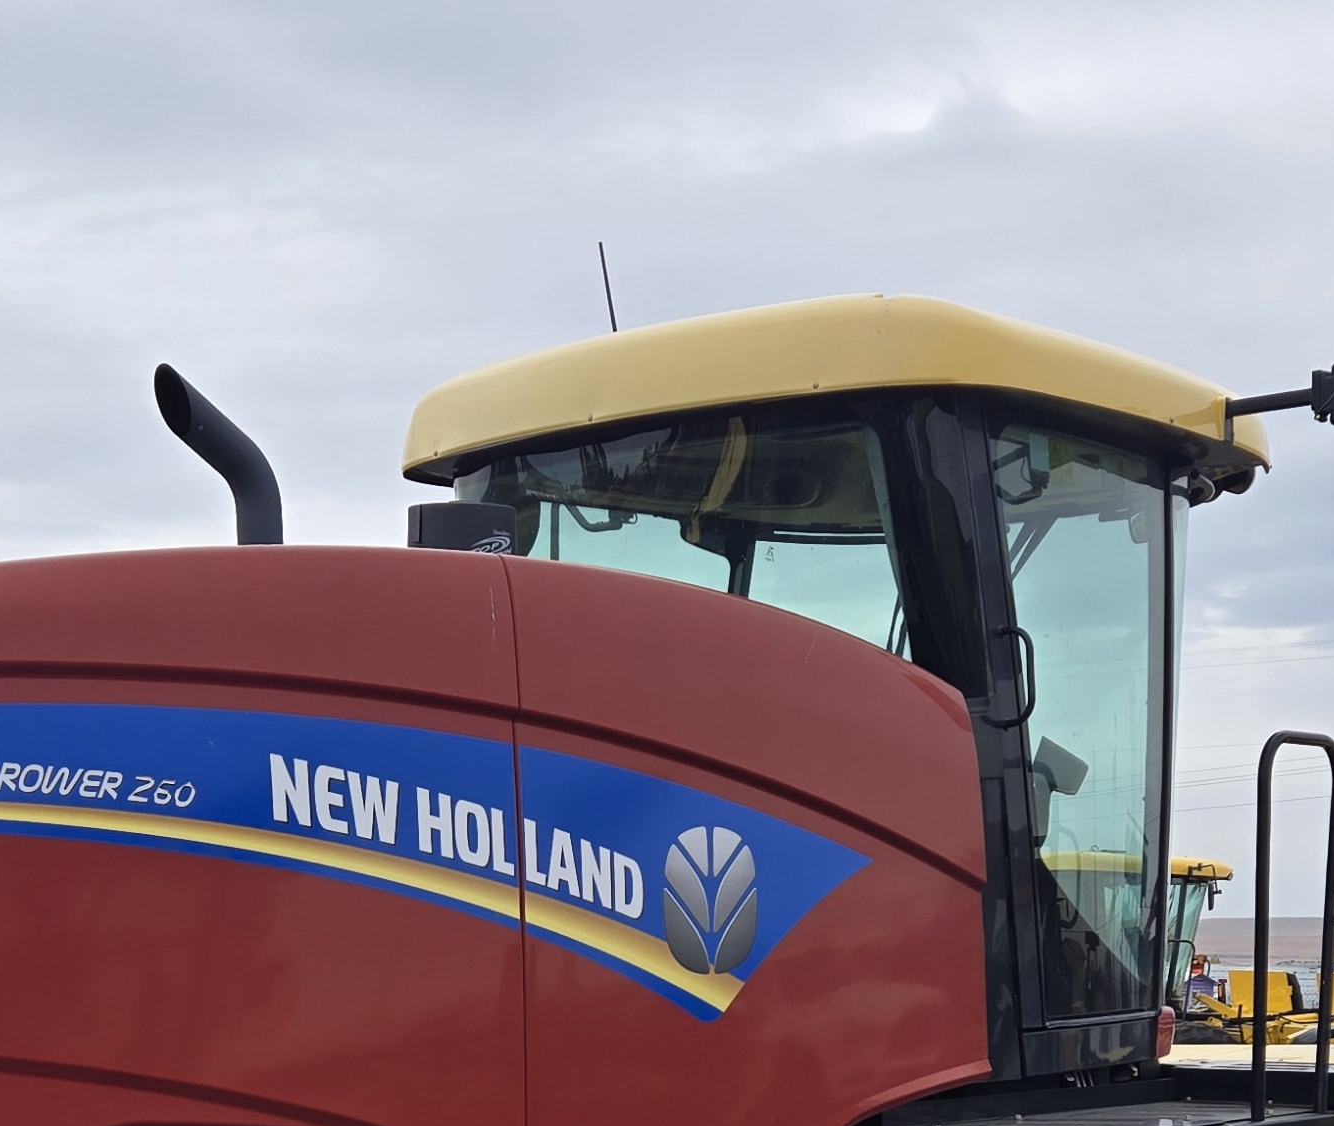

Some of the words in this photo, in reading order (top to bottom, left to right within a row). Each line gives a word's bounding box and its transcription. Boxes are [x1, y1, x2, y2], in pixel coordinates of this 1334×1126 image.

[127, 775, 197, 808] 260
[269, 753, 400, 846] NEW
[416, 786, 644, 920] HOLLAND
